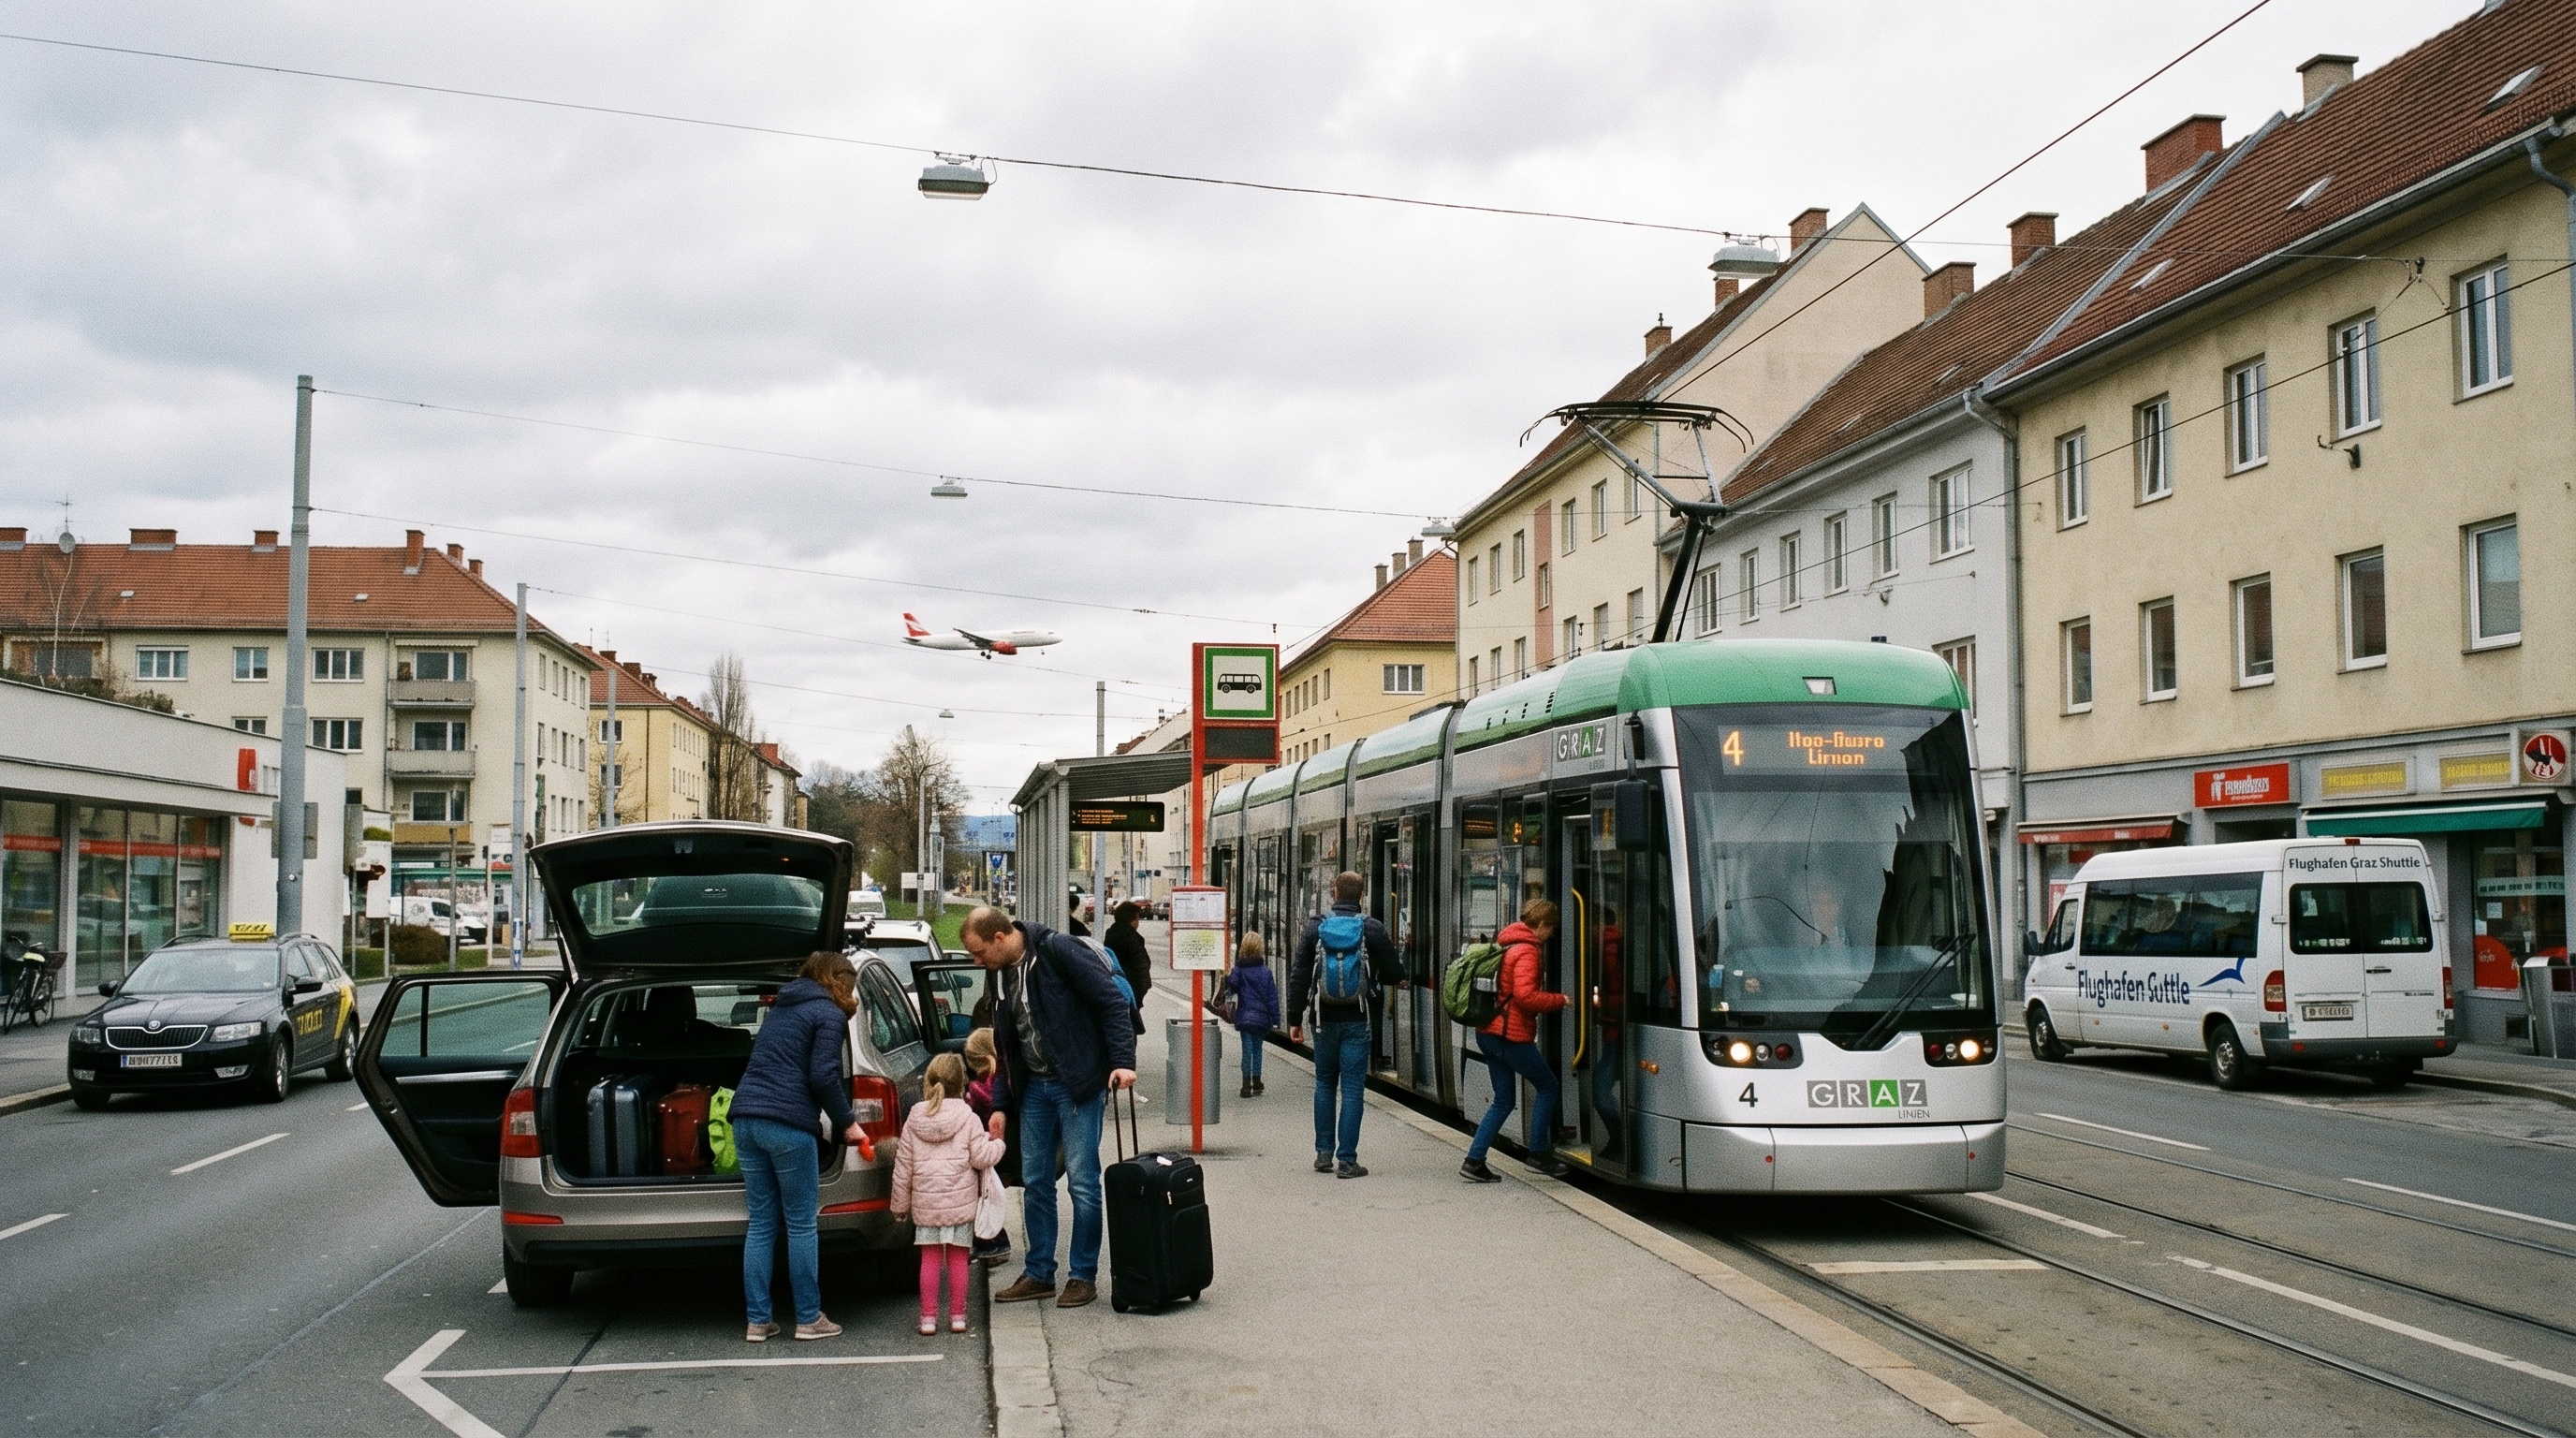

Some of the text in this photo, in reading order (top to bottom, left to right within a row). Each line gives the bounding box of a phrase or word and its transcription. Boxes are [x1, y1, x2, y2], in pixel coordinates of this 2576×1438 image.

[1558, 727, 1604, 759] GRAZ
[1722, 730, 1744, 766] 4
[2289, 858, 2348, 872] Flughafen
[2349, 857, 2378, 869] Graz
[2078, 969, 2144, 1008] Flughafen
[1738, 1082, 1759, 1108] 4
[1811, 1082, 1923, 1107] GRAZ
